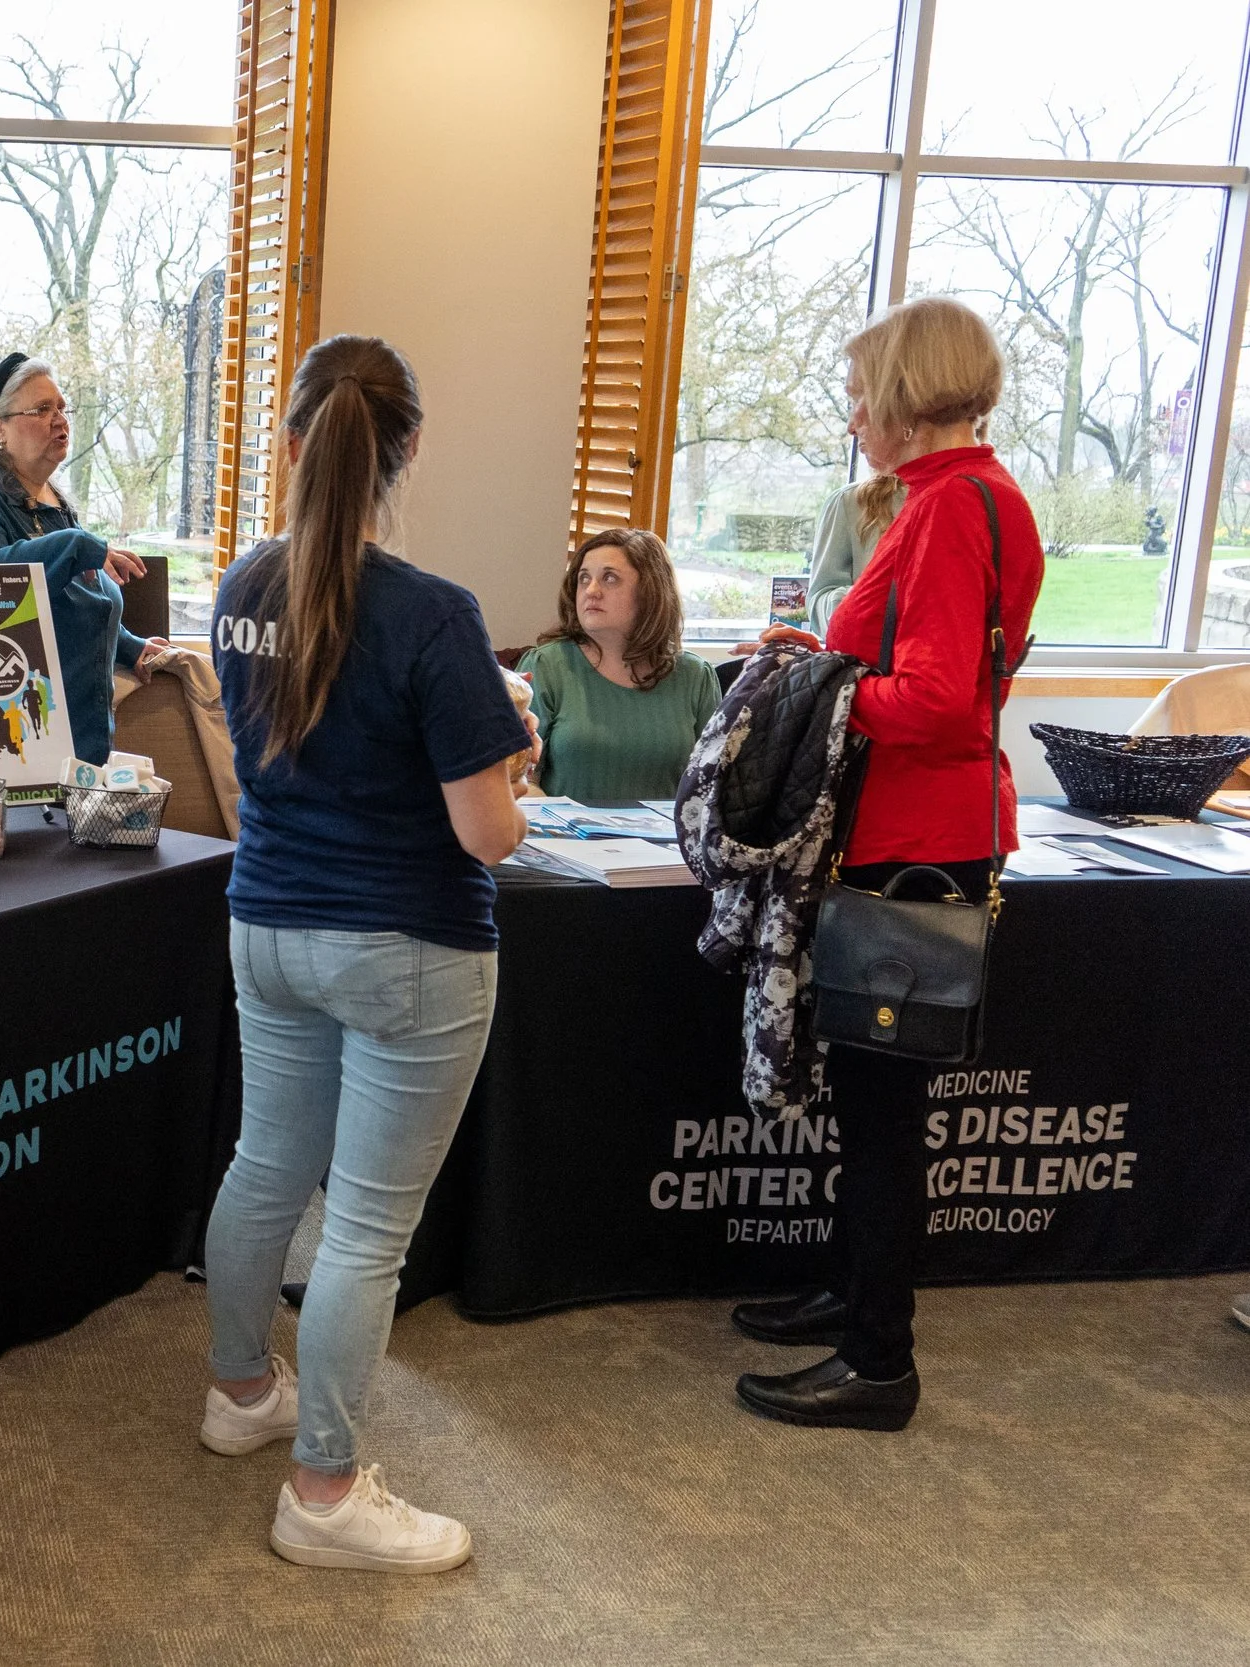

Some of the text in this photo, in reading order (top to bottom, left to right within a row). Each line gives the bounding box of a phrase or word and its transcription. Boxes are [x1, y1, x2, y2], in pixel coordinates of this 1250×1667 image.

[957, 1103, 1129, 1145] DISEASE
[650, 1167, 811, 1210] CENTER
[927, 1152, 1137, 1198] XCELLENCE
